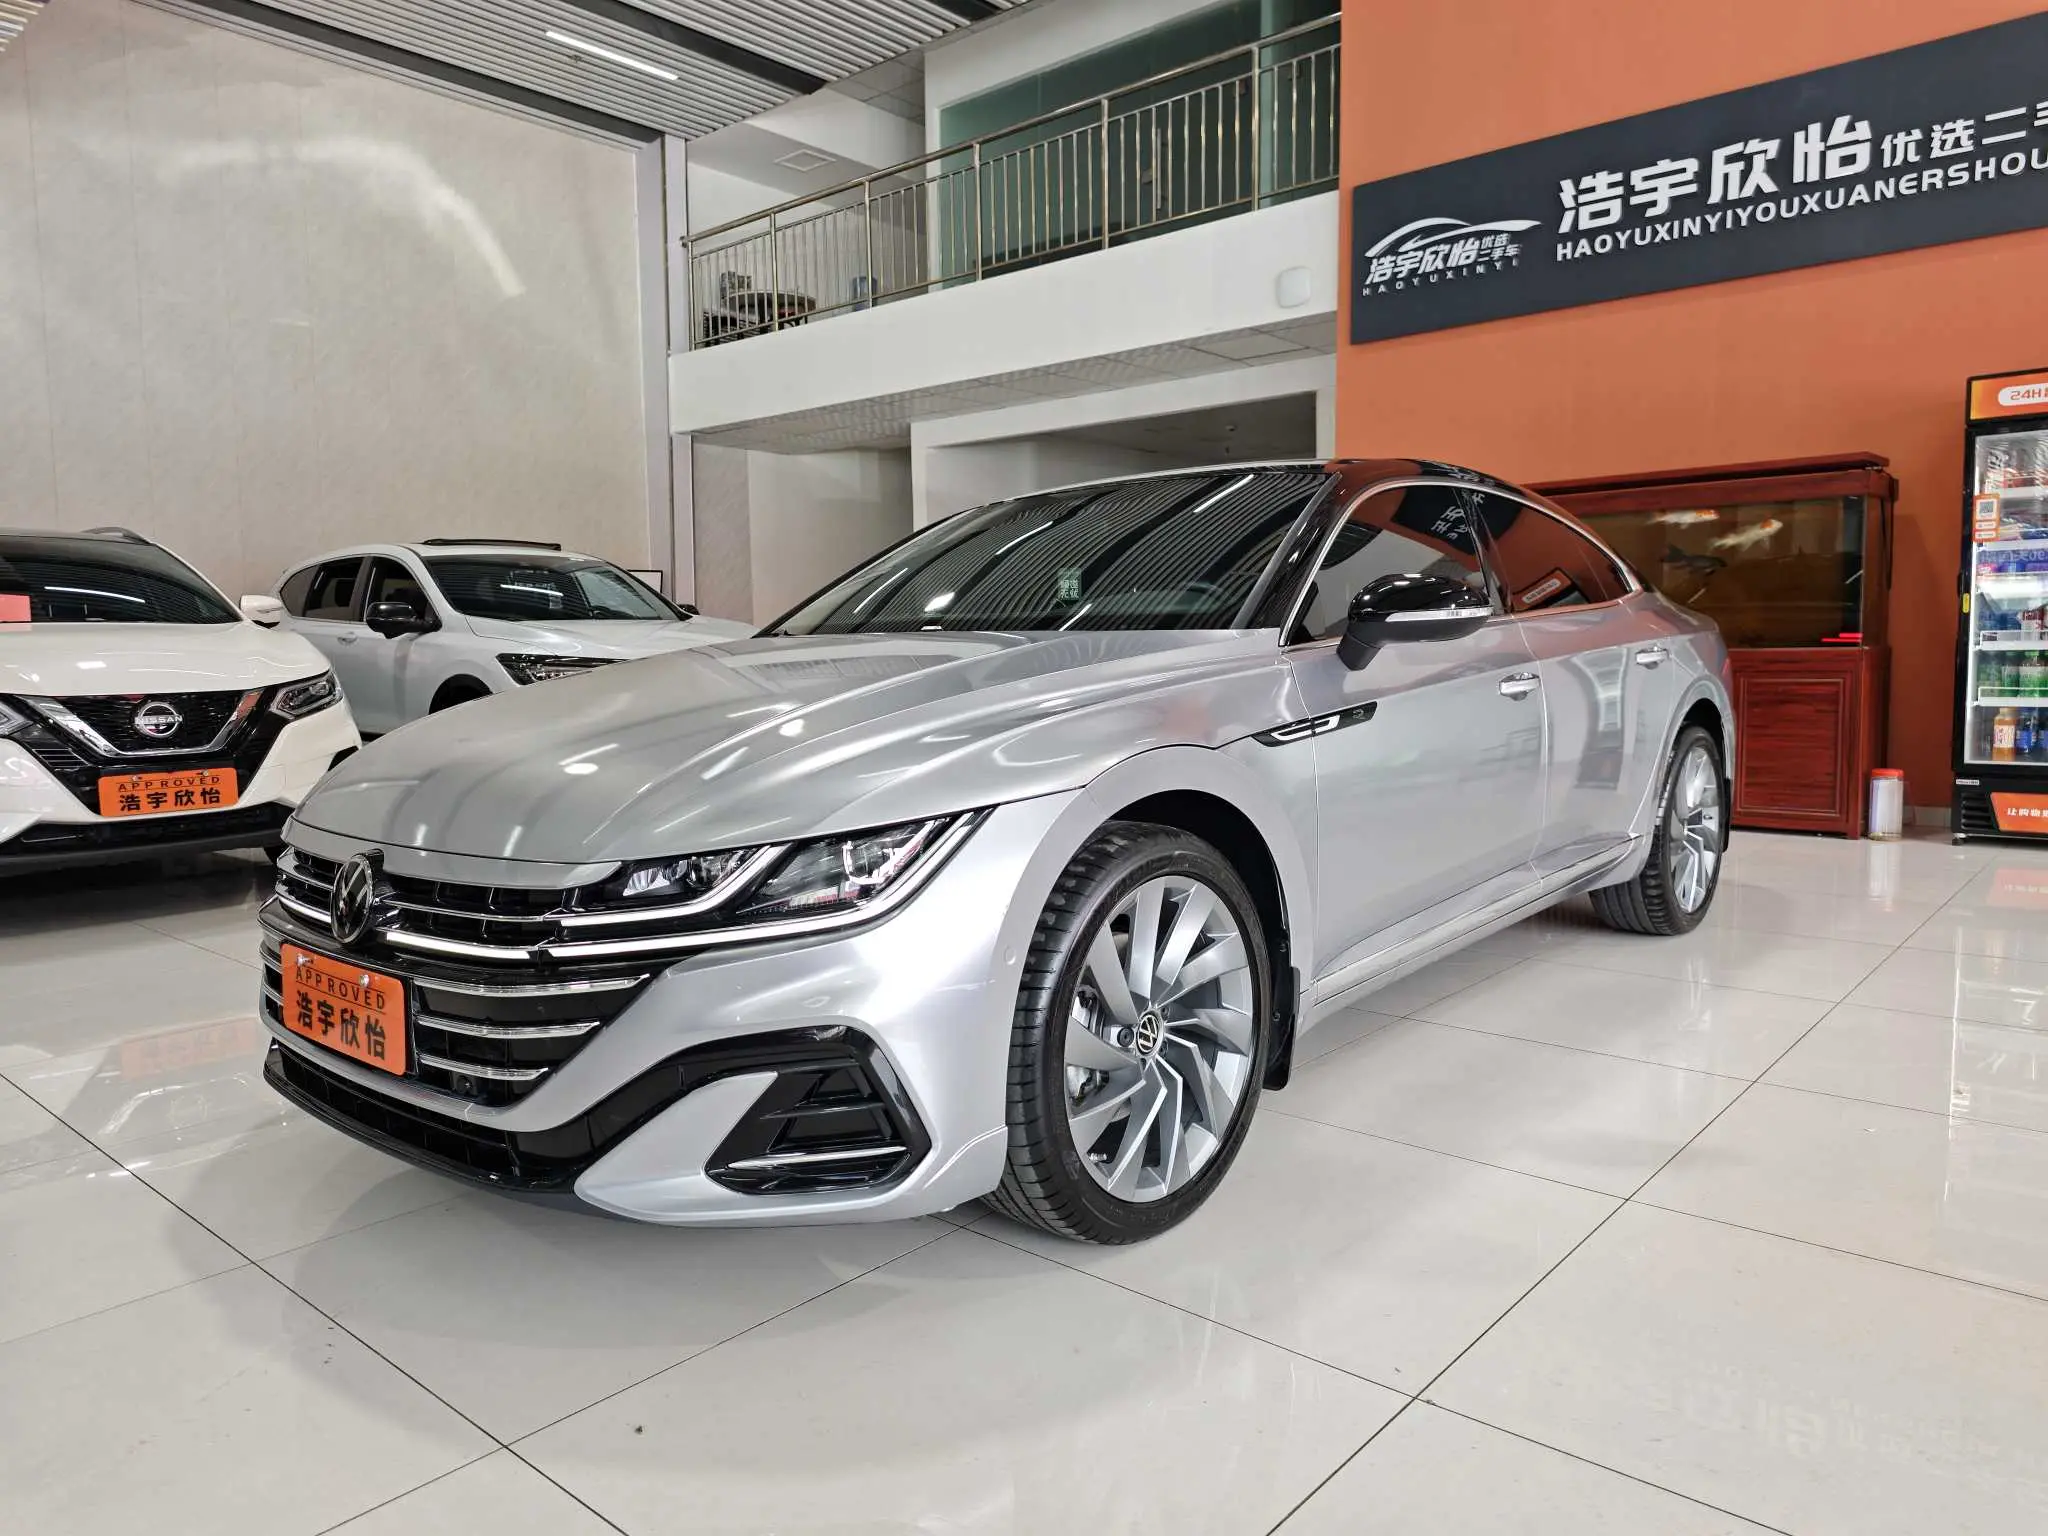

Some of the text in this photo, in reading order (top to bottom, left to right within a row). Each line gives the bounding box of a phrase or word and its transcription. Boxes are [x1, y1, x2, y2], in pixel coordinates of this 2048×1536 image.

[1364, 237, 1481, 285] 浩宇欣怡
[134, 714, 183, 724] NISSAN
[118, 776, 220, 791] APPROVED
[119, 787, 221, 812] 浩宇欣怡
[296, 965, 386, 1010] APPROVED
[296, 989, 387, 1061] 浩宇欣怡
